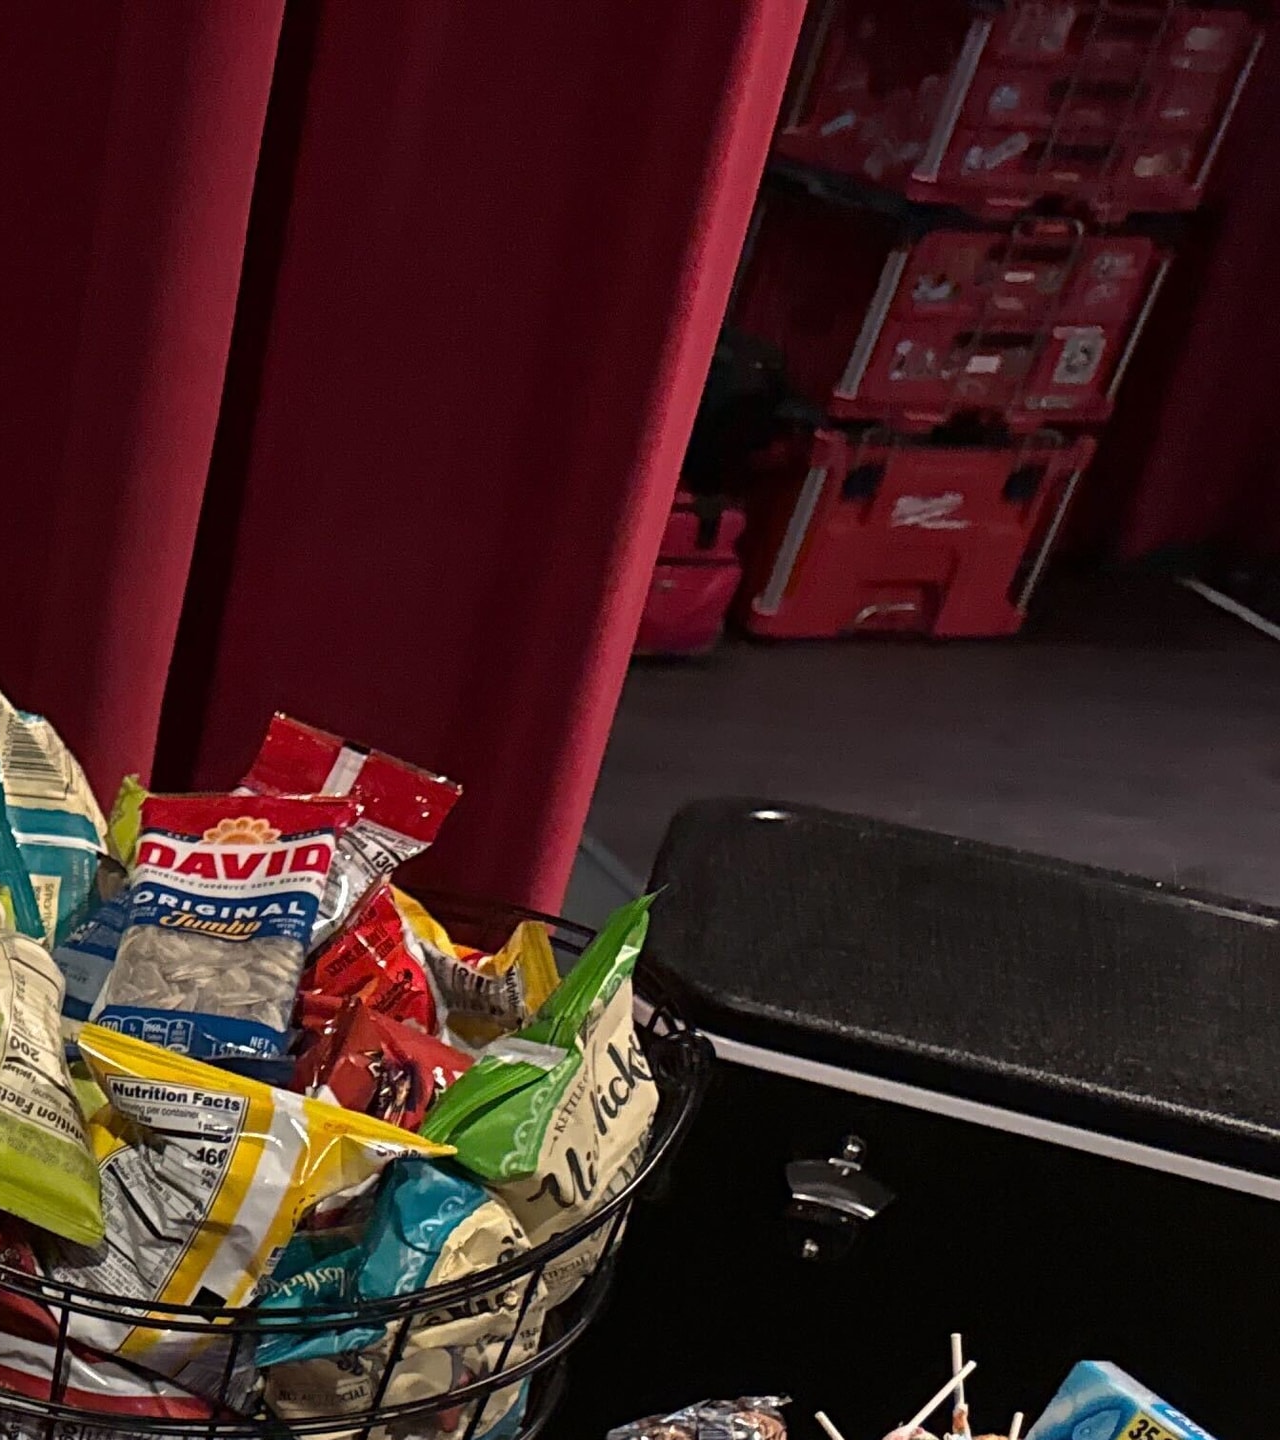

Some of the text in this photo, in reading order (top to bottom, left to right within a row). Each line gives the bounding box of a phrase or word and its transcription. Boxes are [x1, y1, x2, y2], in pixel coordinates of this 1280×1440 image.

[137, 841, 334, 881] DAVID
[132, 889, 309, 920] ORIGINAL
[159, 911, 263, 937] Jumbo
[8, 1036, 40, 1062] 200
[112, 1082, 241, 1111] Nutrition Facts
